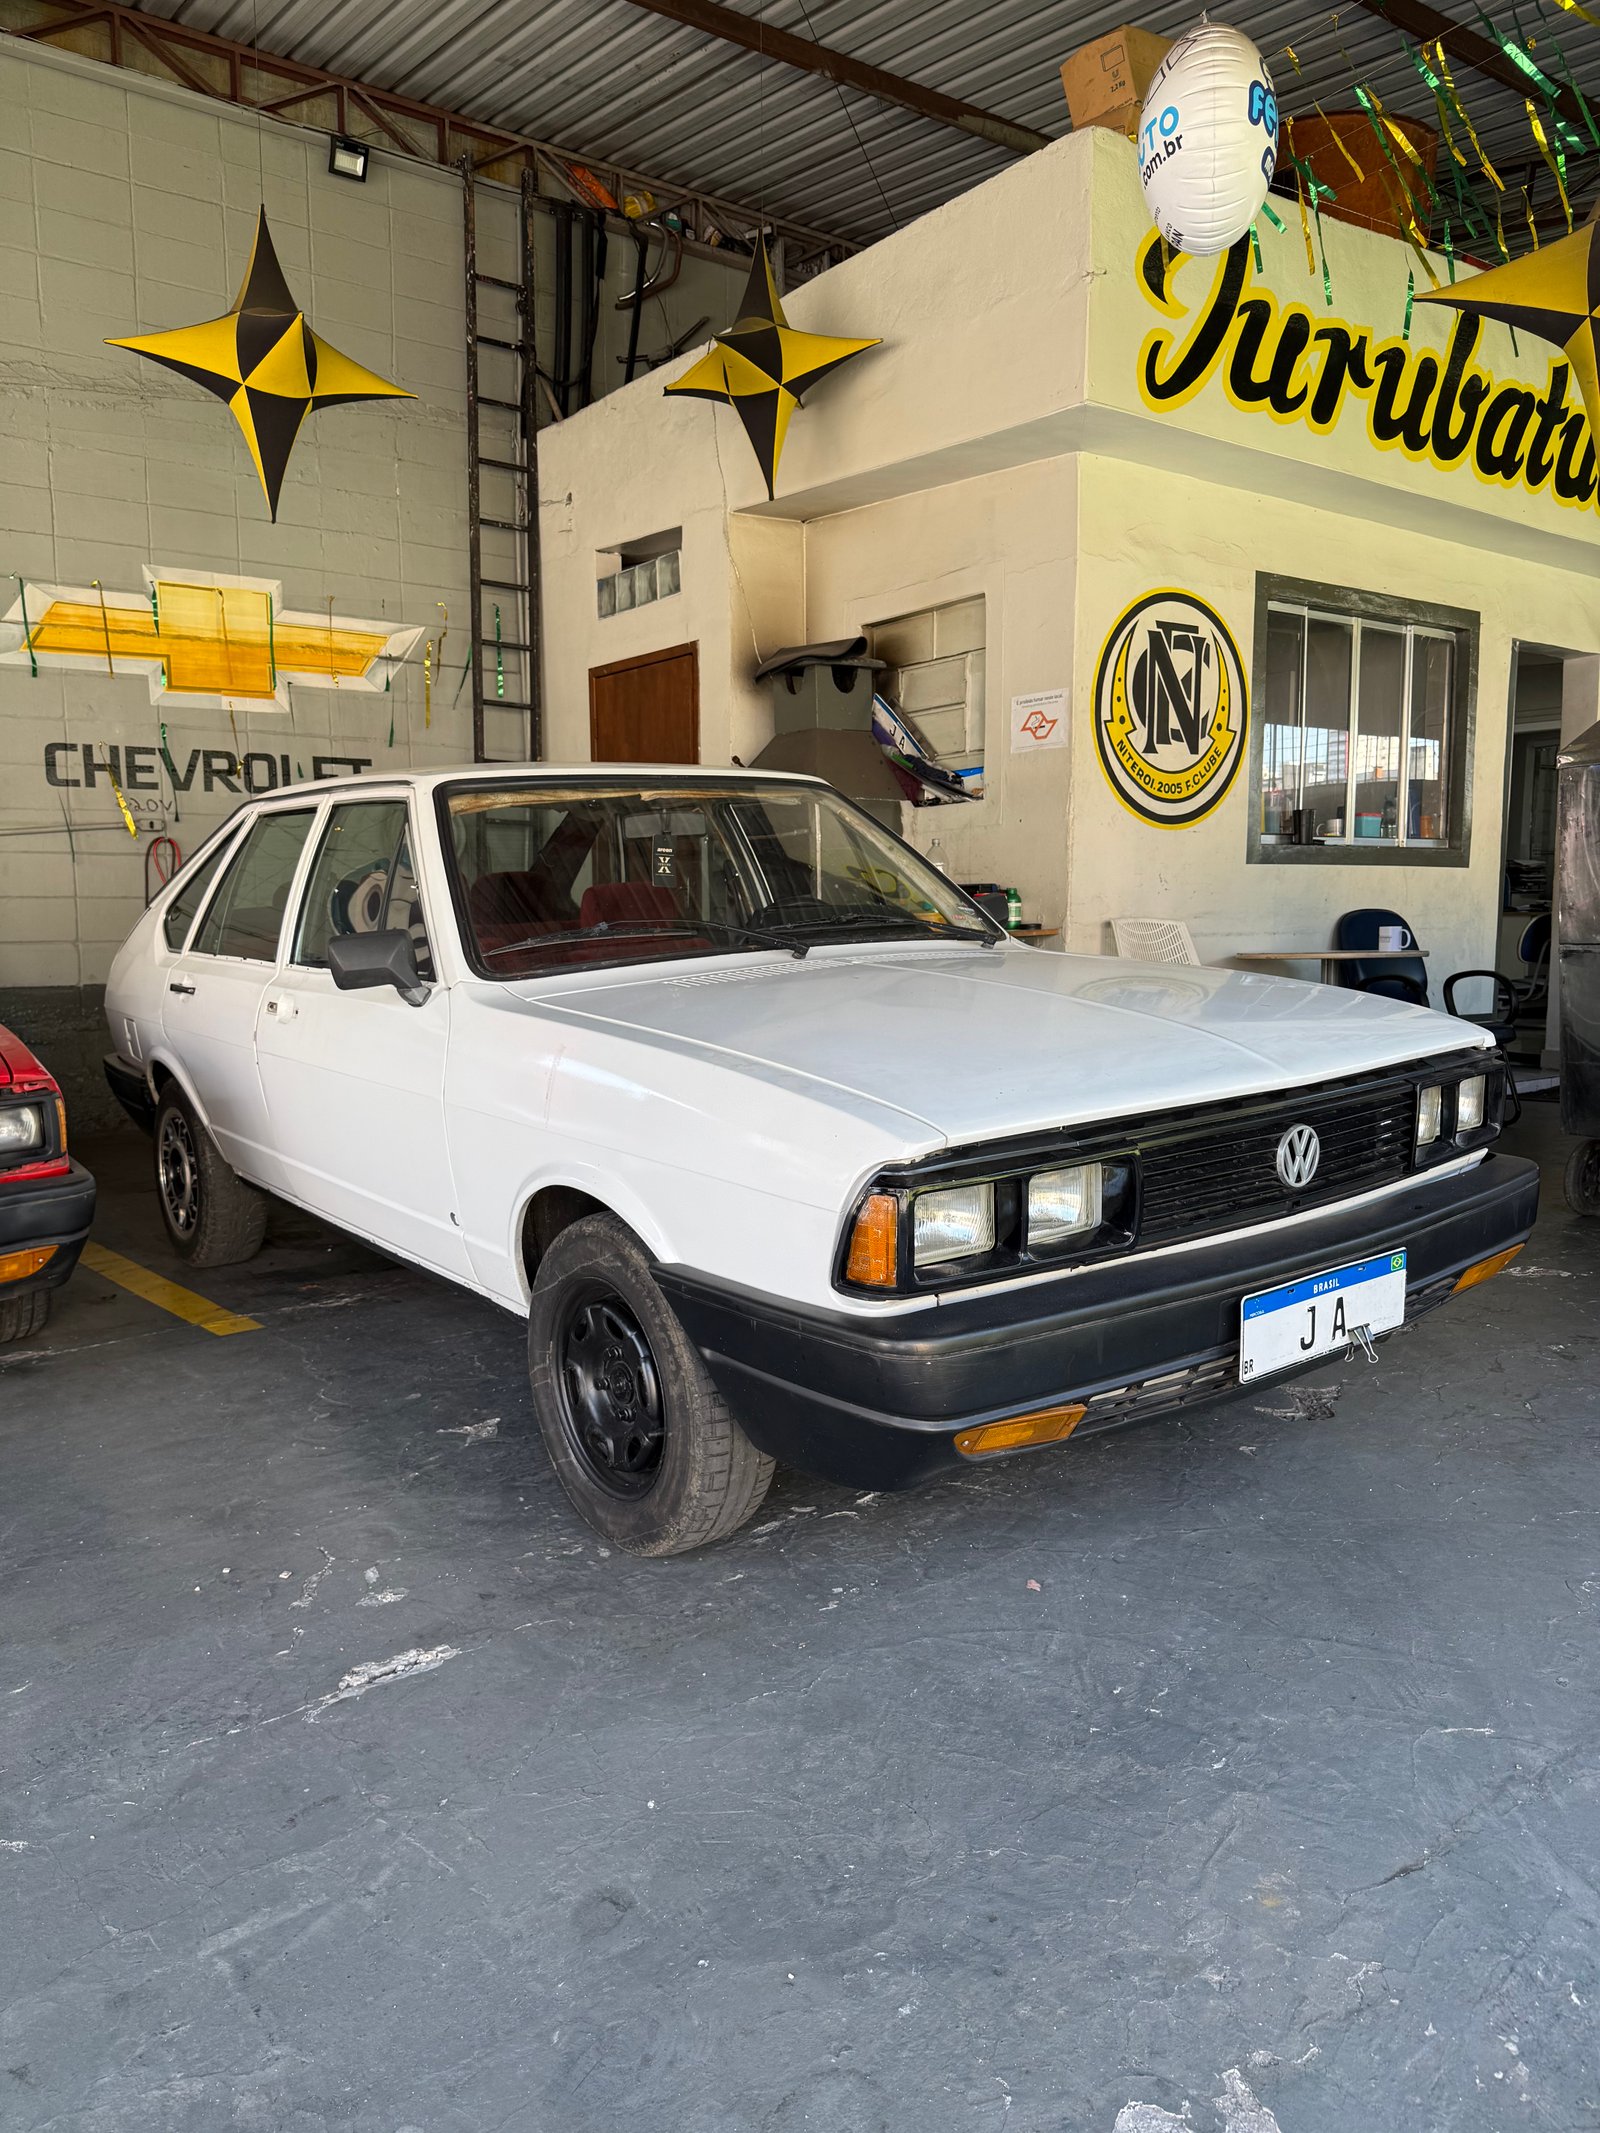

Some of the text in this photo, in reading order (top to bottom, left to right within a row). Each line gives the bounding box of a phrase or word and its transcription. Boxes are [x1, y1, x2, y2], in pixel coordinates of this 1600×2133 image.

[1142, 226, 1600, 504] Jurubatu
[1313, 1278, 1340, 1294] BRASIL
[1300, 1296, 1346, 1351] J A
[1243, 1358, 1254, 1375] BR
